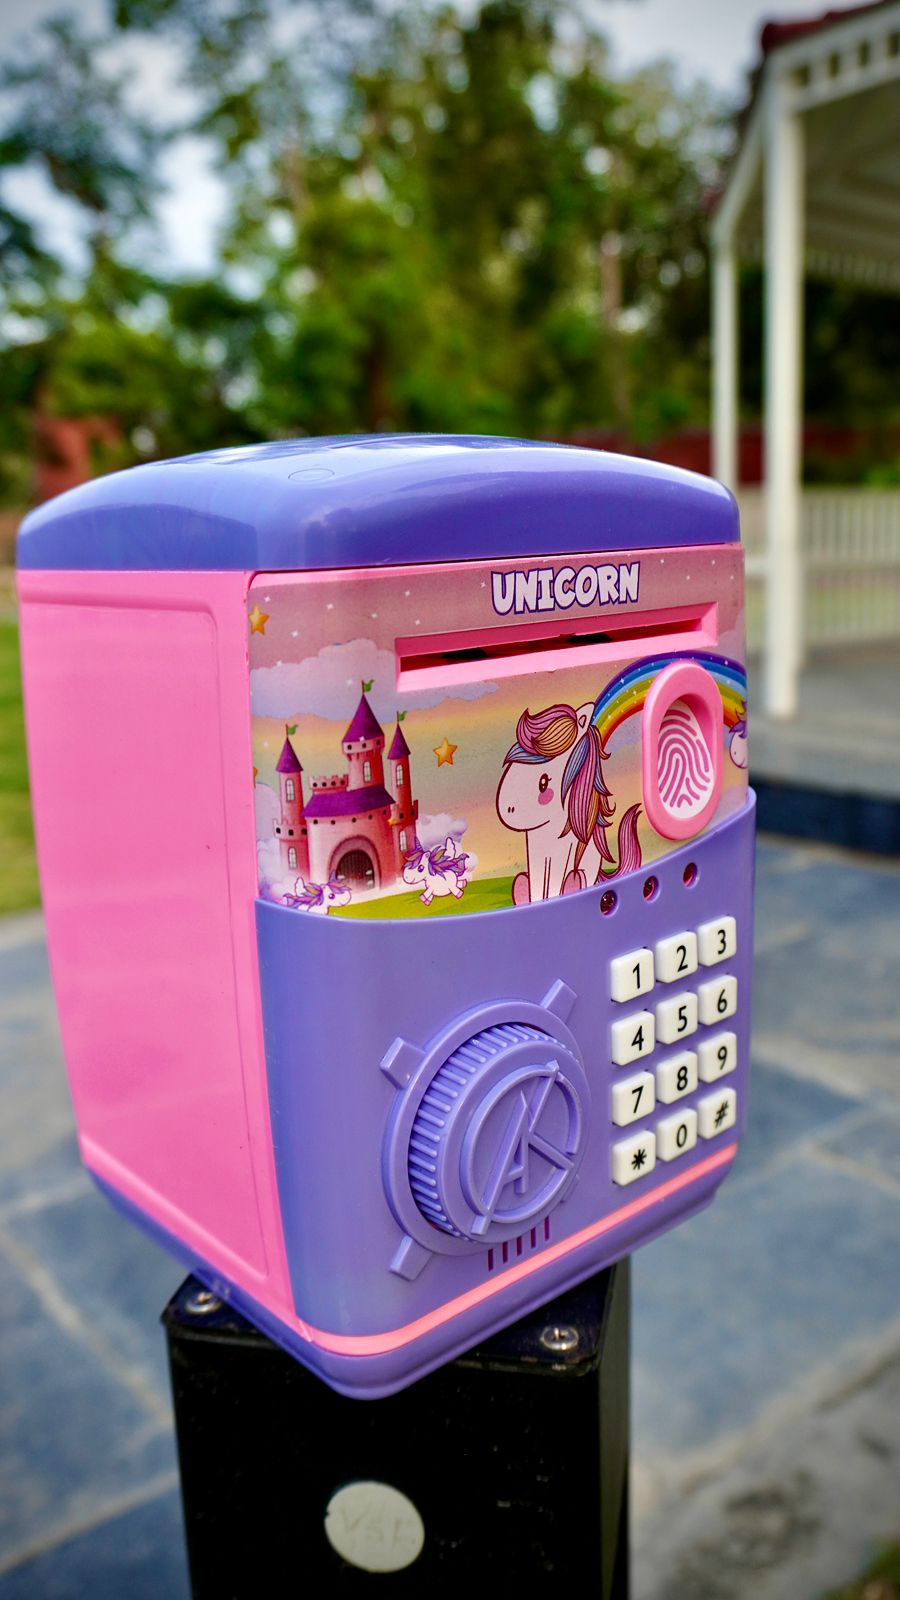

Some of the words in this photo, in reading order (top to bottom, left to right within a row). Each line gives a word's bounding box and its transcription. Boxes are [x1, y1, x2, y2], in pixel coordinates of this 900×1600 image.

[491, 561, 641, 616] UNICORN
[632, 962, 641, 989] 1
[676, 945, 688, 972] 2
[717, 929, 727, 955] 3
[631, 1025, 645, 1051] 4
[677, 1005, 687, 1032] 5
[717, 989, 728, 1014] 6
[631, 1086, 645, 1114] 7
[677, 1066, 688, 1091] 8
[717, 1046, 728, 1071] 9
[676, 1124, 687, 1148] 0
[714, 1100, 729, 1127] #
